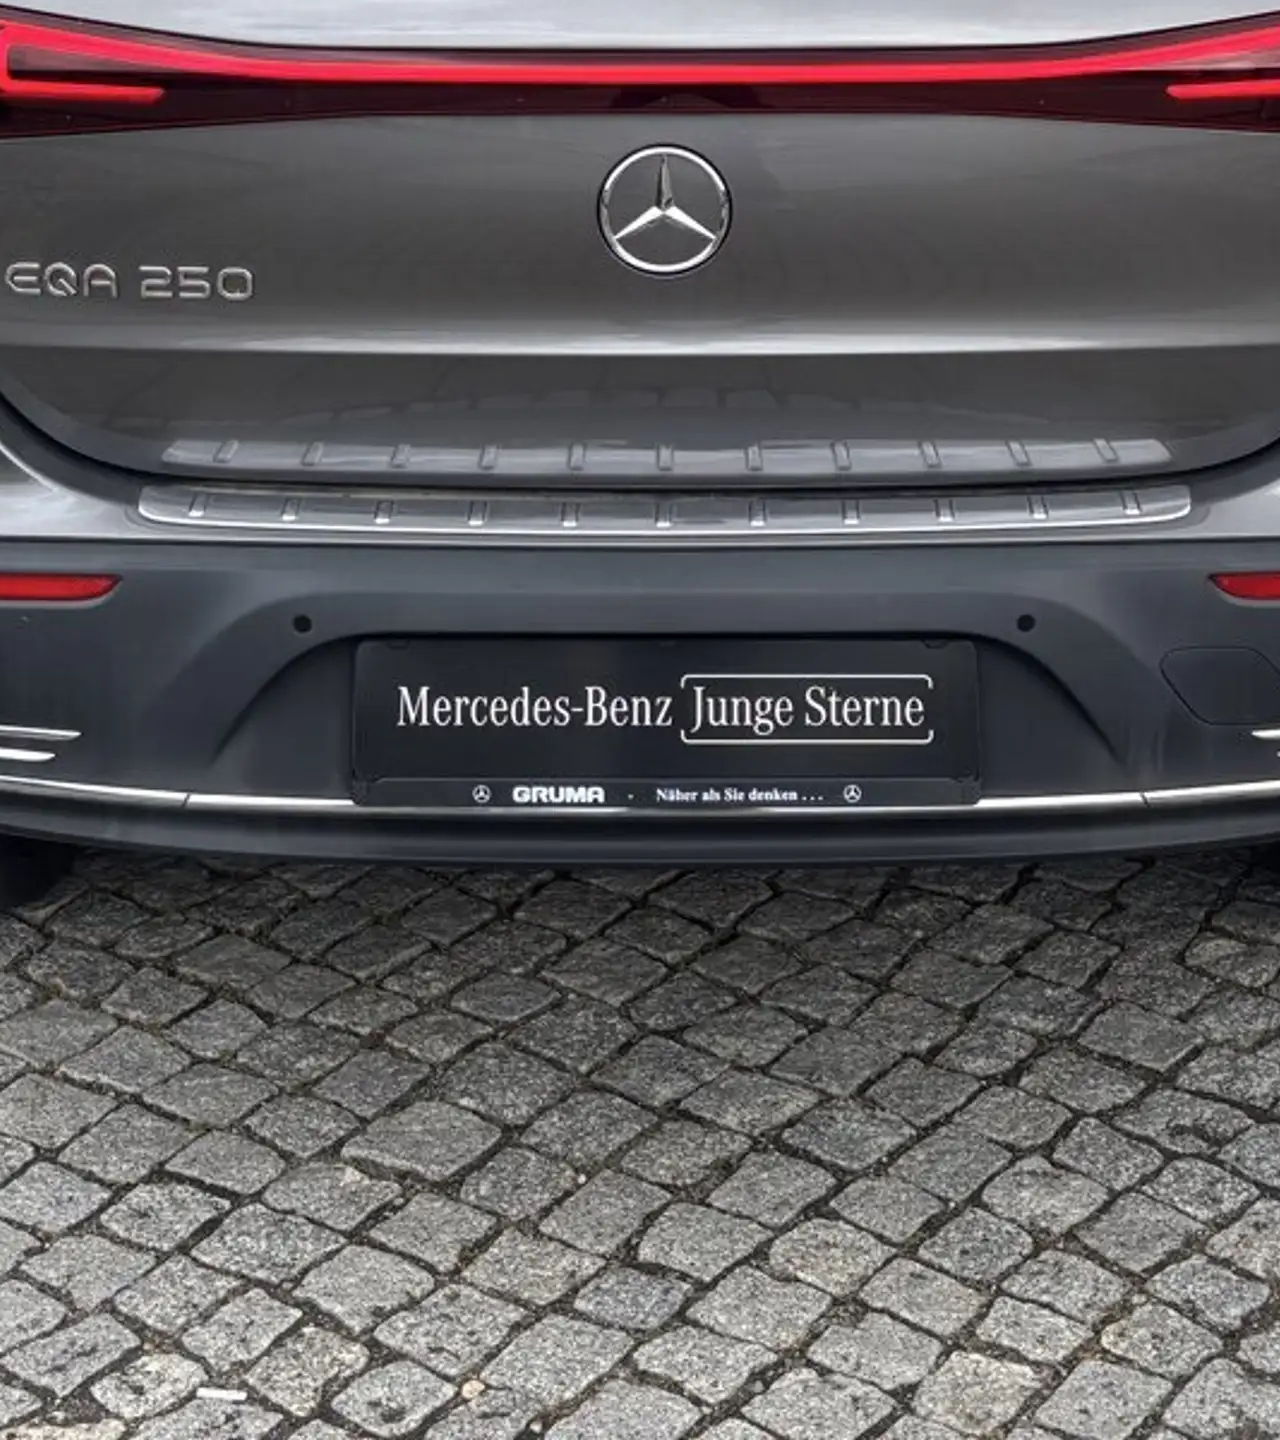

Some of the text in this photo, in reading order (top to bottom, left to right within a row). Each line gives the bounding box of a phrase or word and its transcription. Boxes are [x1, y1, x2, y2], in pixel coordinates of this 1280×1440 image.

[4, 261, 254, 300] EQA 250
[397, 685, 925, 735] Mercedes-Benz Junge Sterne
[511, 785, 606, 803] GRUMA
[702, 787, 721, 801] als
[724, 787, 745, 801] Sie
